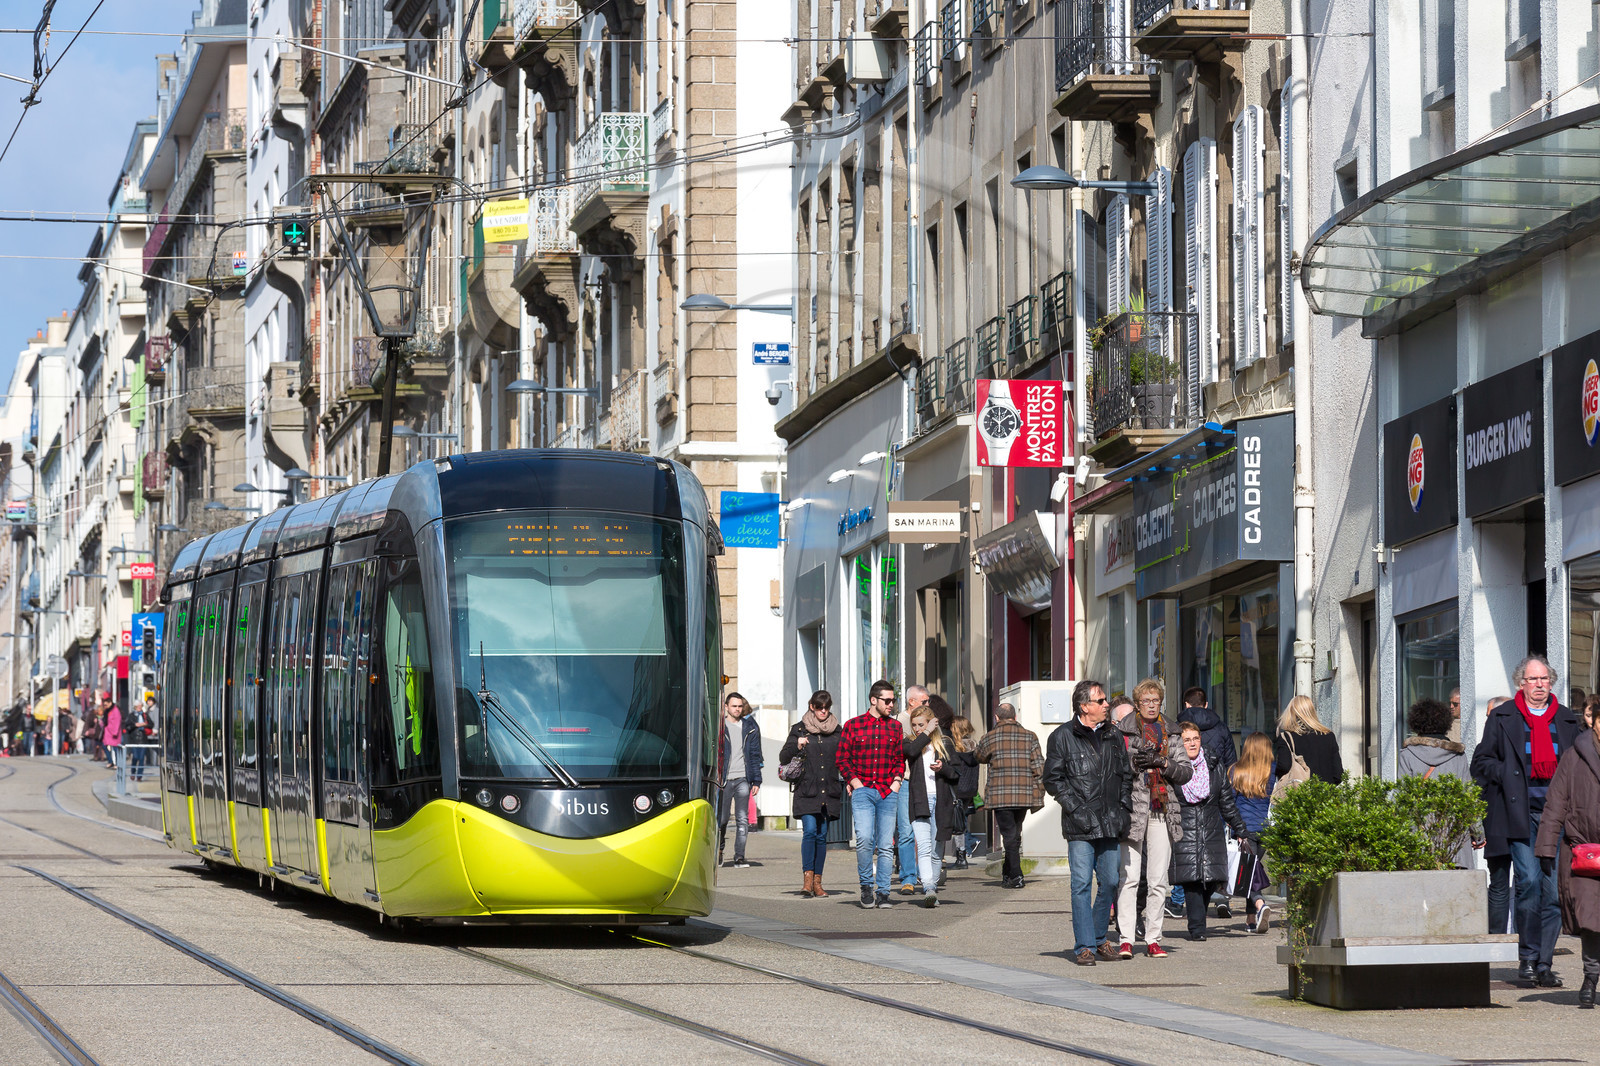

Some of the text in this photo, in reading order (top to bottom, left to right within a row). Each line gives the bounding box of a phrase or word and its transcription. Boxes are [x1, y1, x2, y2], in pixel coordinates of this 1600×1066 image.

[1027, 385, 1040, 462] MONTRES
[1041, 385, 1056, 462] PASSION
[1466, 410, 1532, 470] BURGER KING
[743, 511, 773, 523] c'est
[1137, 502, 1174, 551] OBJECTIF
[1193, 472, 1237, 529] CADRES
[1243, 436, 1261, 544] CADRES
[737, 523, 773, 536] deux
[894, 518, 955, 527] SAN MARINA
[132, 566, 153, 574] ORPI
